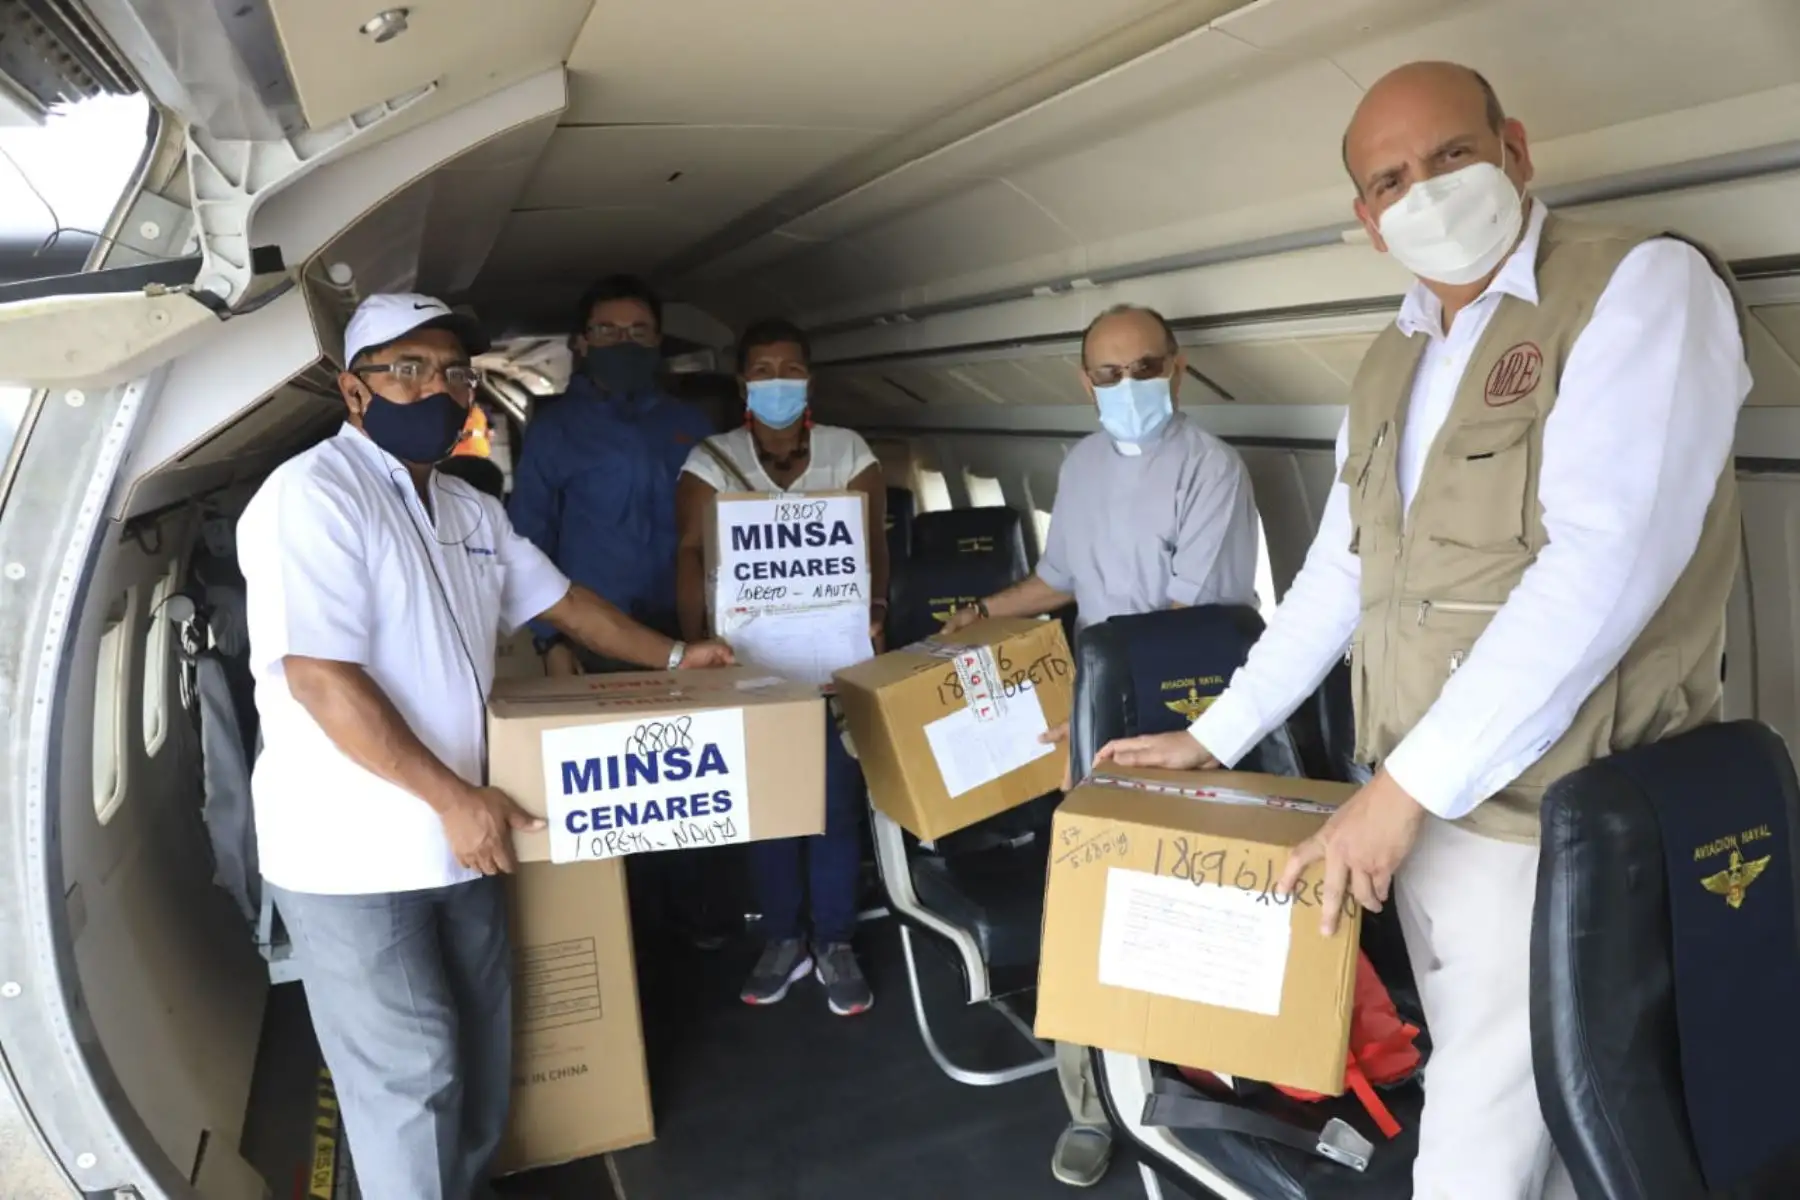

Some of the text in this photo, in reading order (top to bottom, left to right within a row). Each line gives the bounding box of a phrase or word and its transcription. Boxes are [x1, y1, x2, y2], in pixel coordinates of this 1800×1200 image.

[1487, 351, 1539, 396] MRE
[773, 501, 827, 522] 18808
[731, 520, 854, 552] MINSA
[734, 556, 856, 581] CENARES
[561, 742, 729, 796] MINSA
[565, 789, 732, 835] CENARES
[548, 1063, 588, 1082] CHINA
